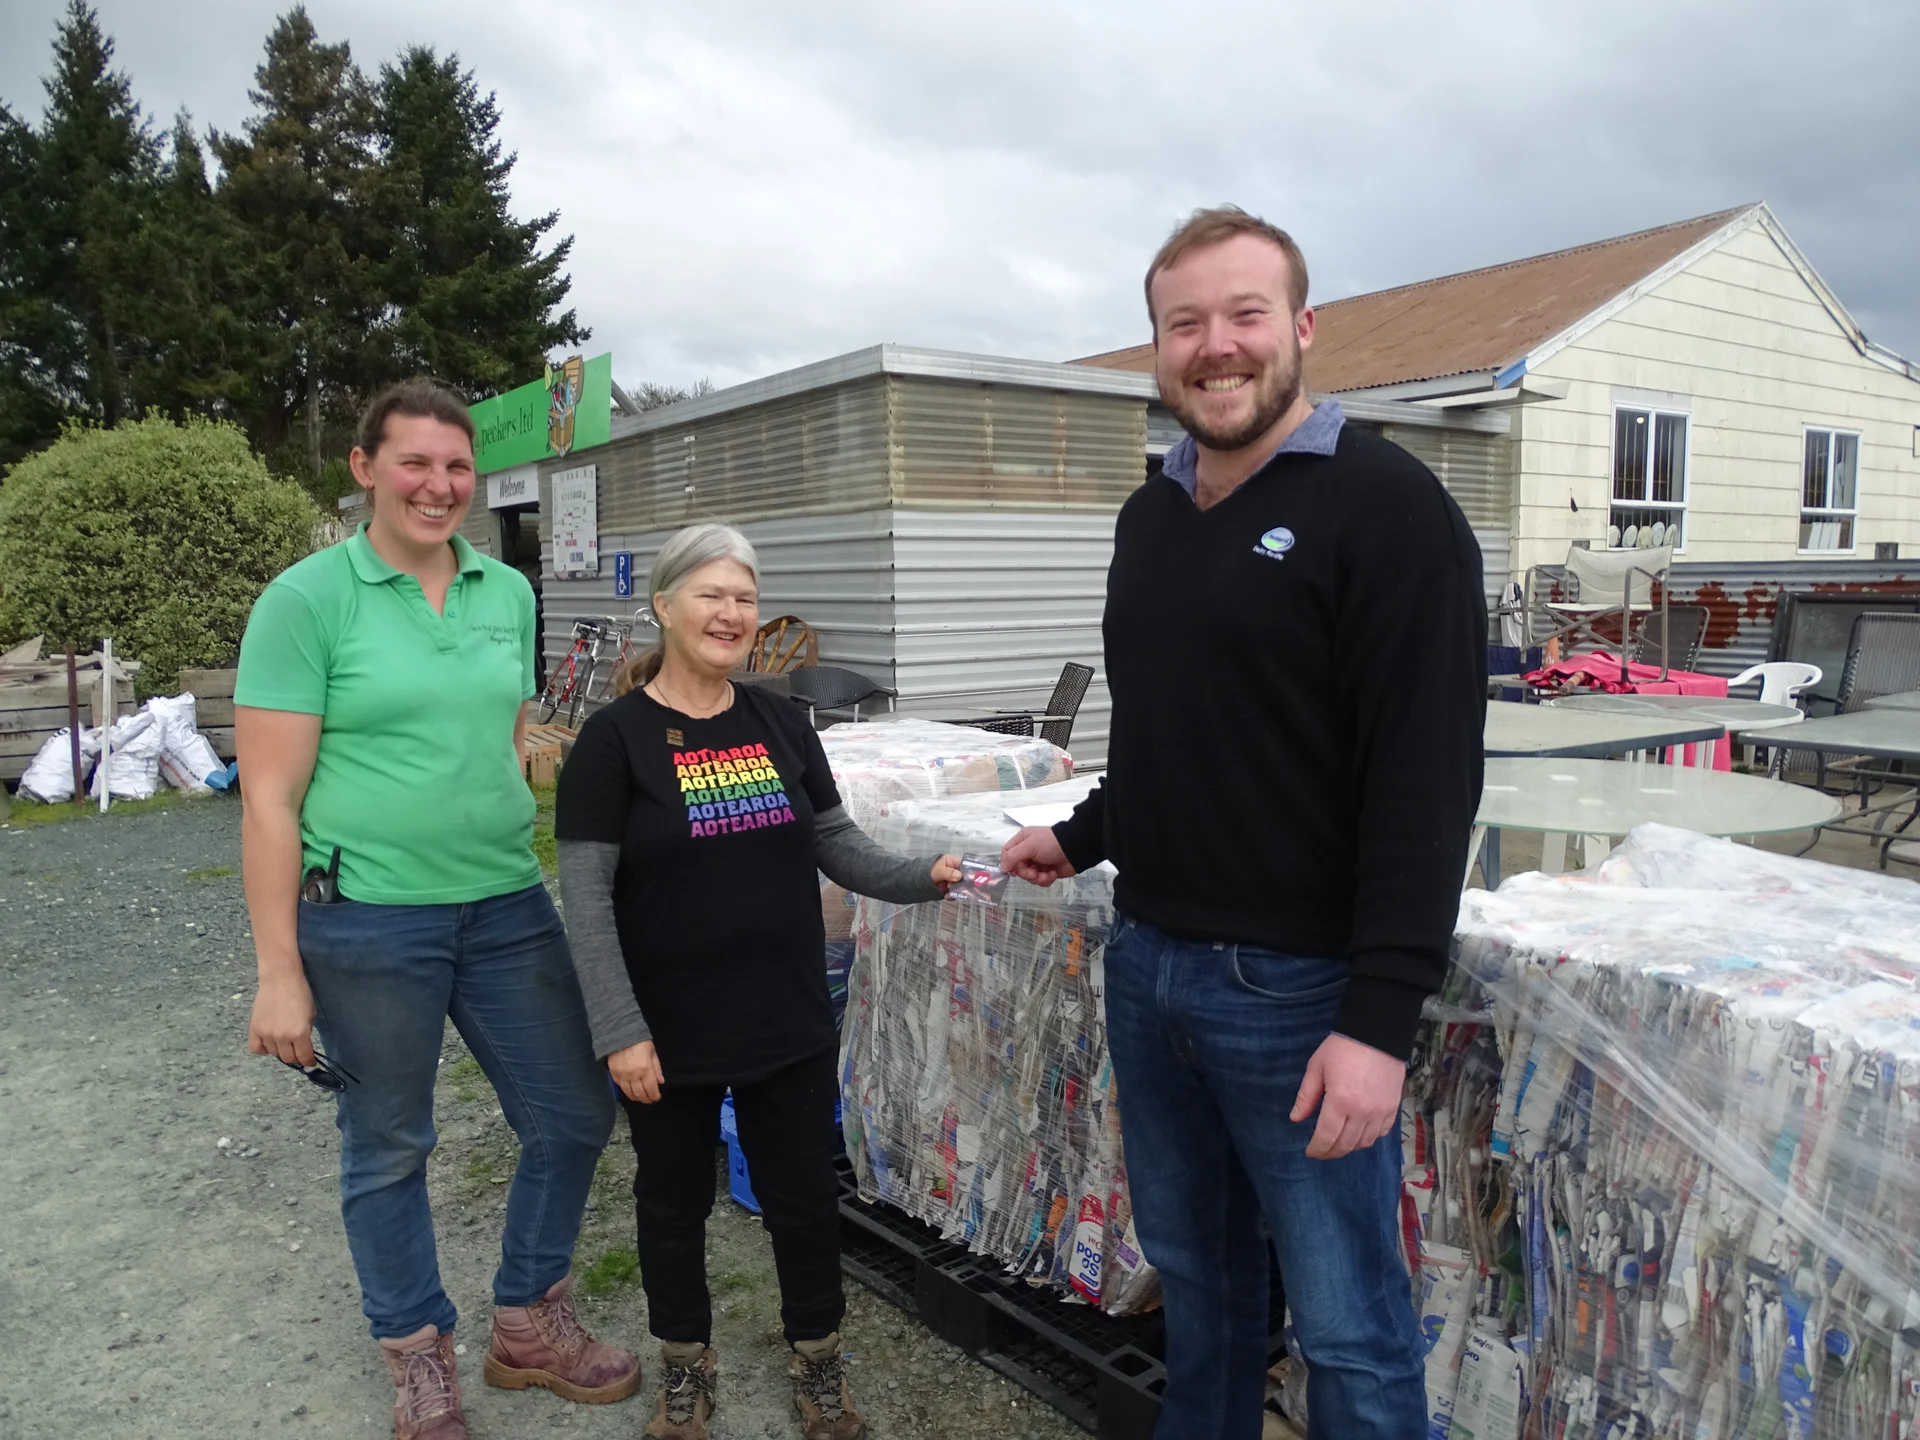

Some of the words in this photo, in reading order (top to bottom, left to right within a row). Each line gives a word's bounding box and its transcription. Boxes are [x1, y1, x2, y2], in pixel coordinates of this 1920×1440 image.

[481, 415, 516, 454] peckers
[519, 403, 534, 435] ltd
[499, 476, 525, 499] Welcome
[673, 743, 769, 765] AOTEAROA
[677, 756, 774, 778] AOTEAROA
[681, 767, 779, 792] AOTEAROA
[685, 780, 785, 806] AOTEAROA
[688, 793, 790, 821] AOTEAROA
[691, 807, 795, 837] AOTEAROA
[1076, 1241, 1102, 1263] ood
